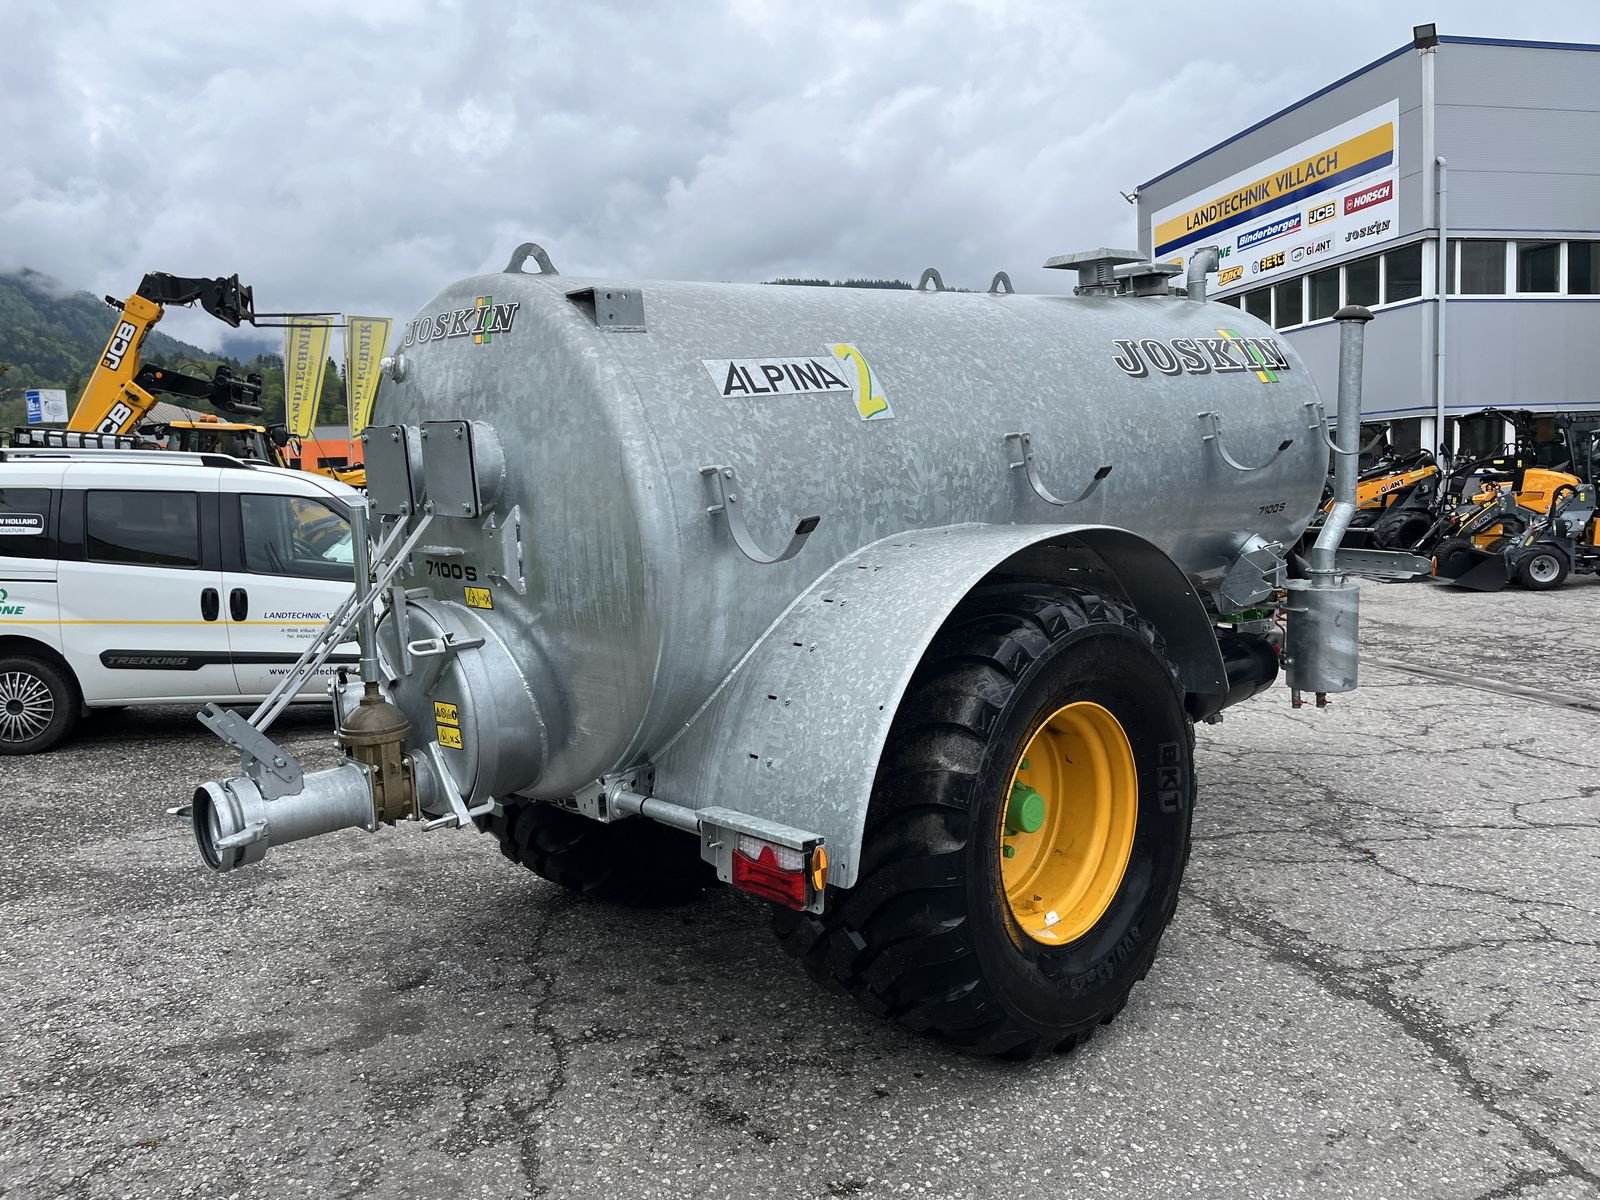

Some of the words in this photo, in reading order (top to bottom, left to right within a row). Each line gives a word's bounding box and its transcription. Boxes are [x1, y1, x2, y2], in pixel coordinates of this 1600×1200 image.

[1186, 180, 1270, 231] LANDTECHNIK
[1276, 151, 1338, 192] VILLACH
[1353, 186, 1390, 208] HORSCH
[1239, 216, 1300, 246] Binderberger
[1309, 203, 1335, 224] JCB
[1344, 220, 1391, 242] JOSKIN
[404, 302, 520, 347] JOSKIN
[103, 321, 137, 370] JCB
[1111, 336, 1291, 379] JOSKIN
[723, 358, 850, 395] ALPINA
[834, 343, 888, 419] 2
[96, 402, 133, 434] CB
[107, 656, 189, 665] TREKKING
[1156, 740, 1183, 814] BKT
